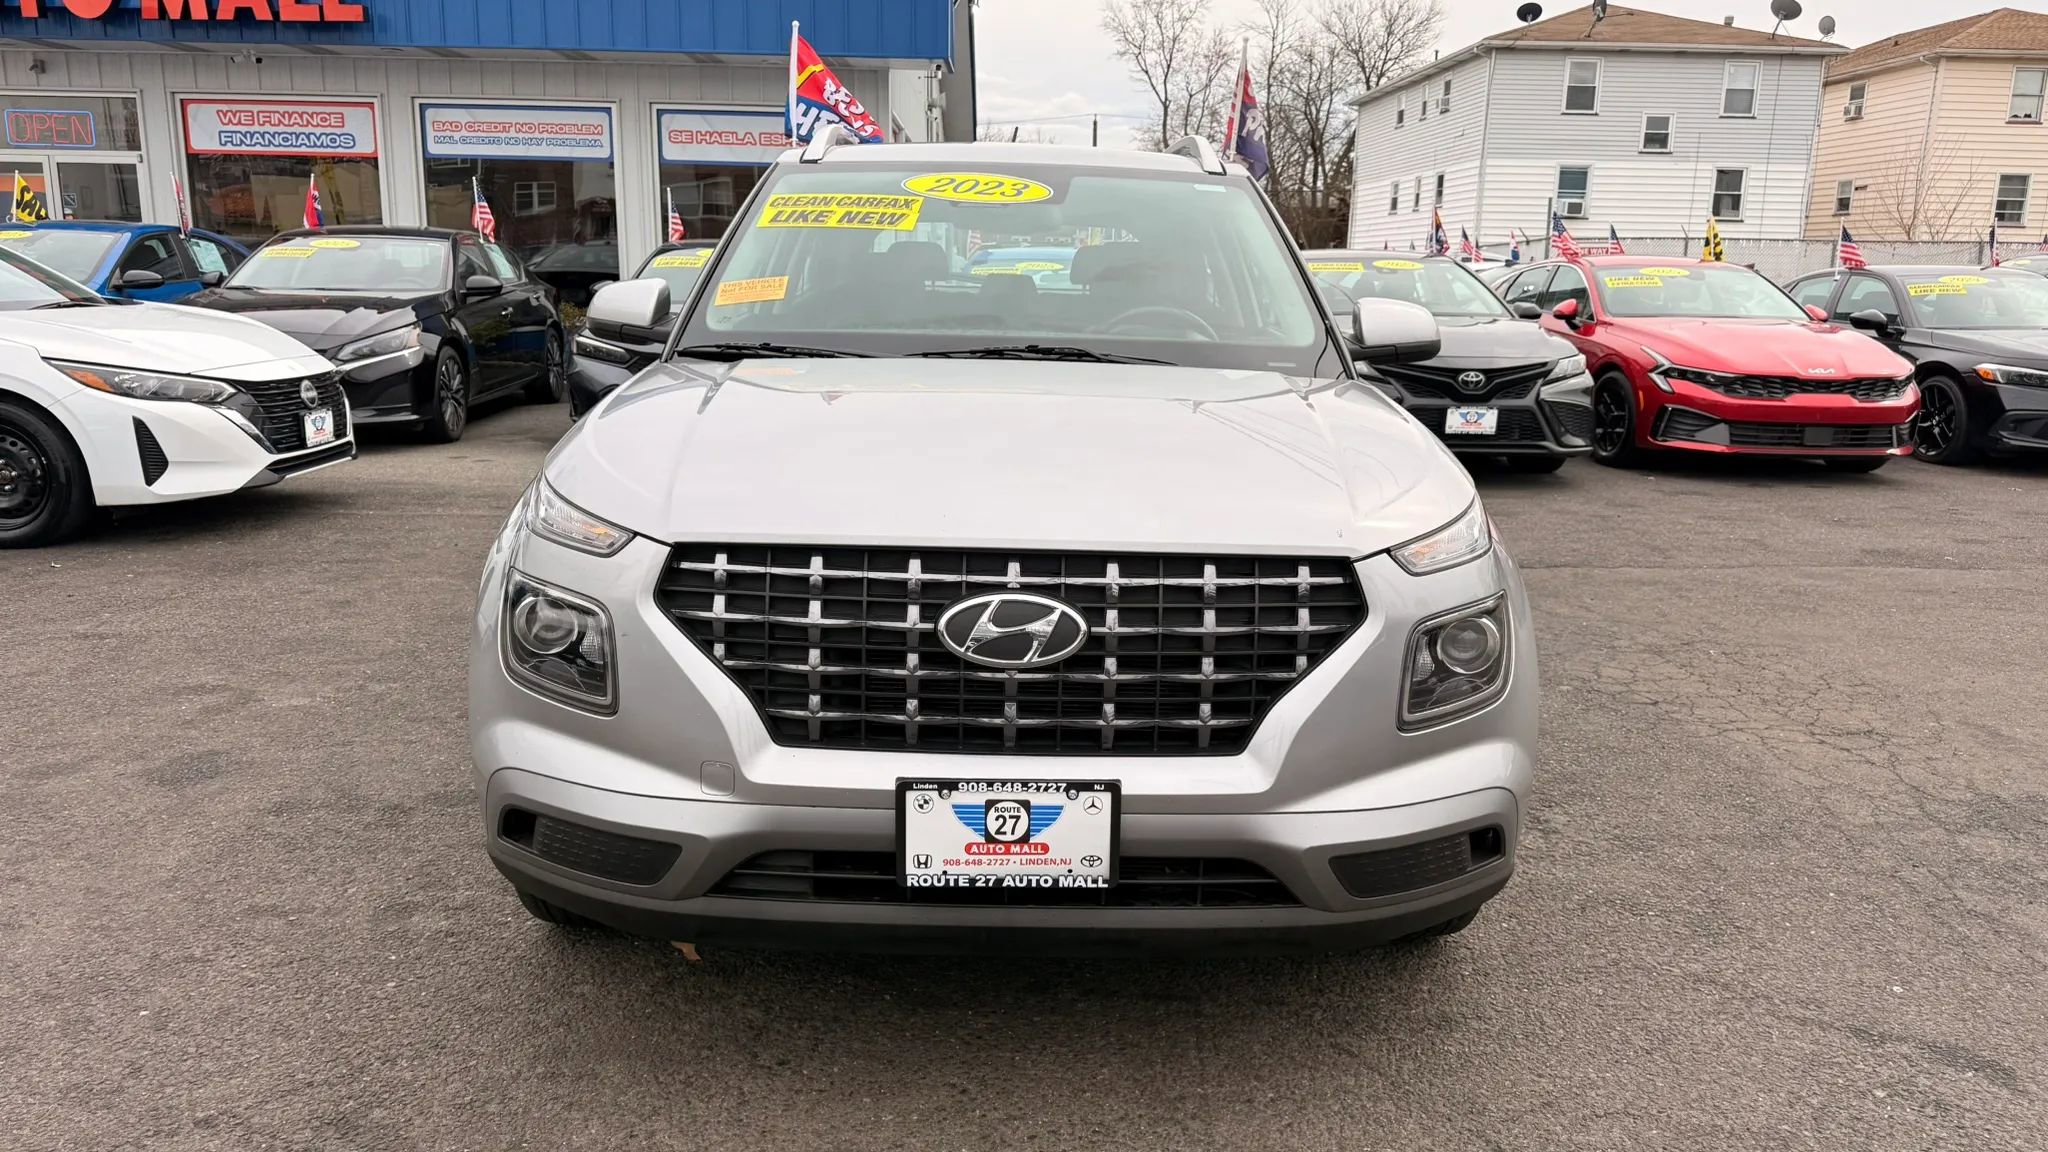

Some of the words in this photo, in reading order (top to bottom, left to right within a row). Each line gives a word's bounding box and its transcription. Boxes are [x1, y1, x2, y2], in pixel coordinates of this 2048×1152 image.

[216, 110, 254, 126] WE
[255, 111, 345, 128] FINANCE
[9, 112, 92, 144] OPEN
[432, 121, 463, 132] BAD
[464, 122, 513, 133] CREDIT
[514, 123, 537, 134] NO
[538, 123, 604, 136] PROBLEM
[219, 131, 356, 148] FINANCIAMOS
[433, 135, 458, 144] MAL
[459, 136, 503, 145] CREDITO
[504, 136, 520, 145] NO
[522, 137, 544, 146] HAY
[545, 138, 604, 147] PROBLEMA
[669, 131, 694, 144] SE
[695, 131, 757, 146] HABLA
[925, 177, 1030, 198] 2023
[769, 196, 837, 208] CLEAN
[836, 197, 919, 210] CARFAX
[768, 210, 833, 225] LIKE
[836, 211, 911, 227] NEW
[958, 782, 1067, 793] 908-648-2727
[994, 814, 1022, 835] 27
[969, 844, 1005, 854] AUTO
[1009, 844, 1045, 854] MALL
[943, 858, 1010, 866] 908-648-2727
[1019, 858, 1072, 867] LINDEN,NJ
[906, 875, 970, 887] ROUTE
[975, 875, 997, 887] 27
[1002, 875, 1053, 888] AUTO
[1059, 876, 1109, 888] MALL
